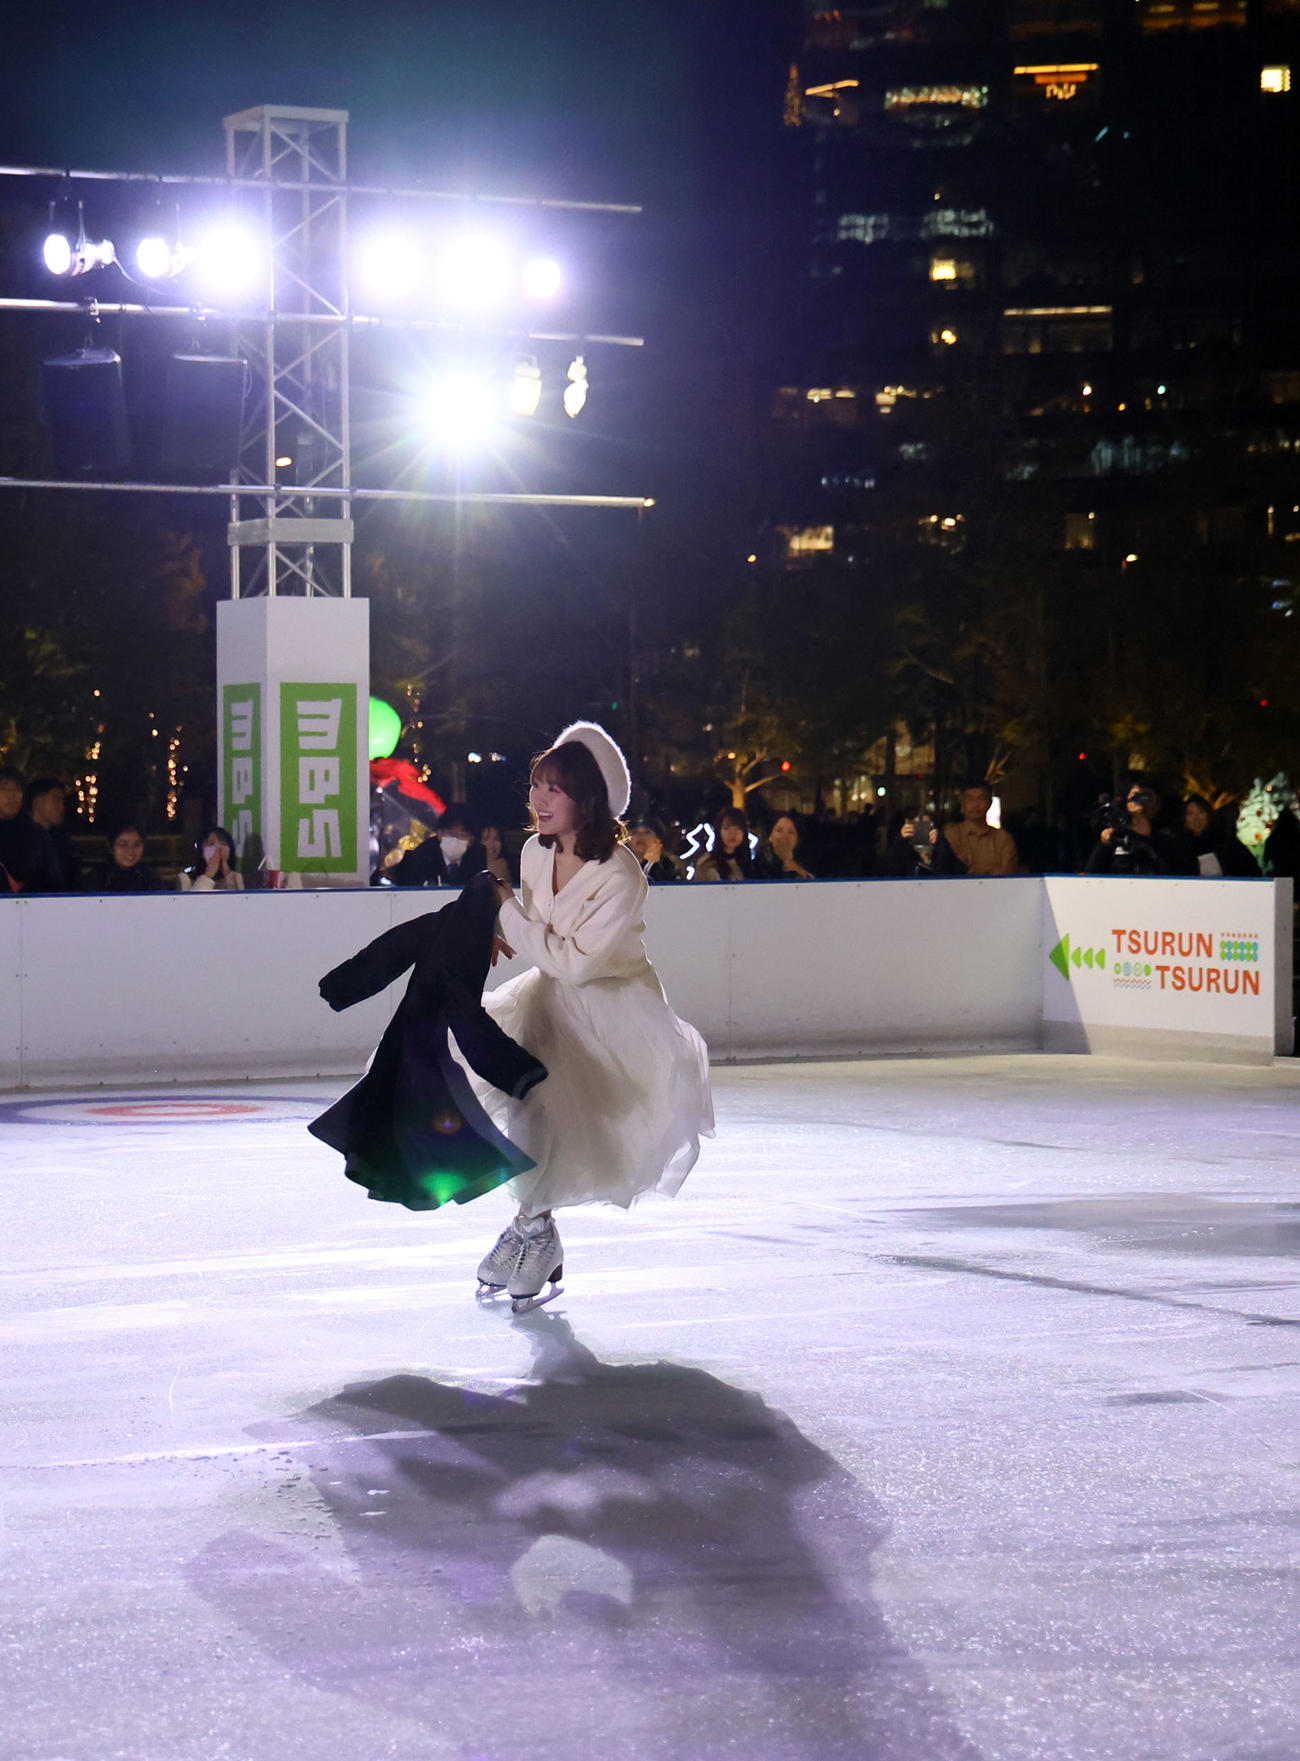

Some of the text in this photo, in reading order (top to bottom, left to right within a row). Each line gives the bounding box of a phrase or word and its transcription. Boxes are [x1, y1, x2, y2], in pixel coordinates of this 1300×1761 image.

[296, 699, 342, 857] MBS
[1112, 929, 1213, 958] TSURUN
[1155, 965, 1260, 996] TSURUN
